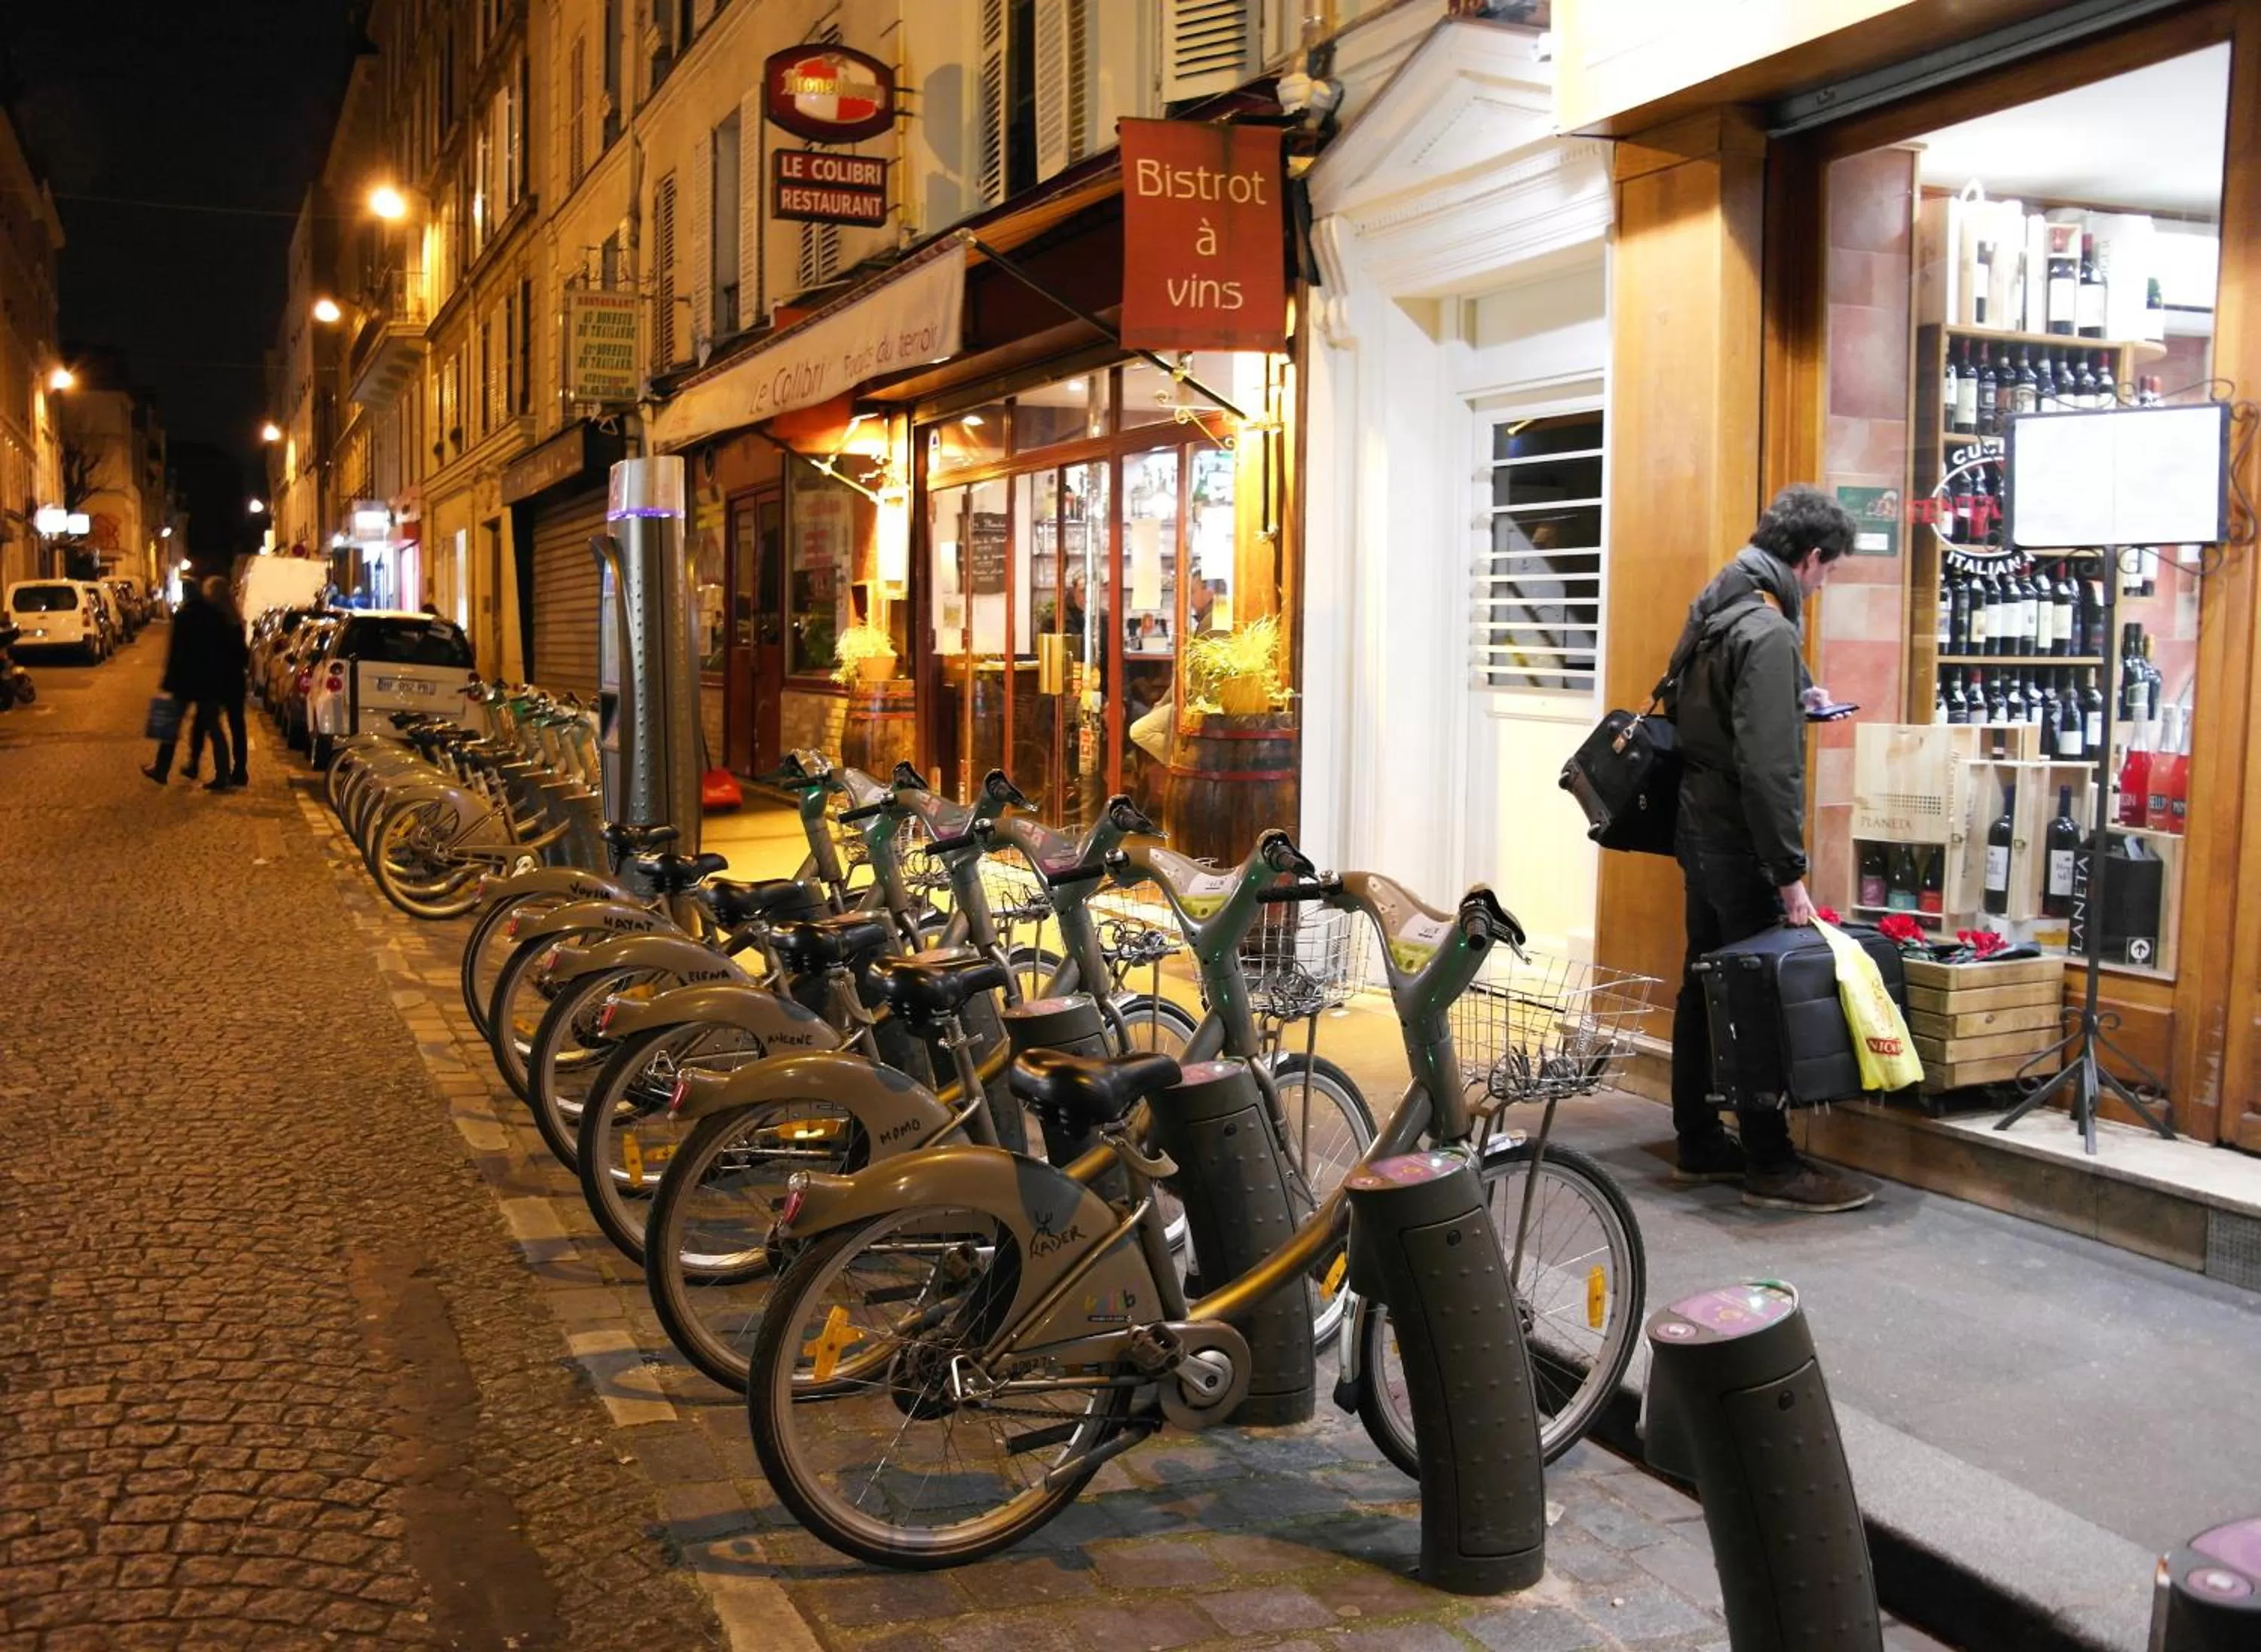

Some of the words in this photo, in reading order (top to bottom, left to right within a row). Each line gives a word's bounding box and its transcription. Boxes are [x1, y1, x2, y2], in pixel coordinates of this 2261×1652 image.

[782, 156, 803, 178] LE
[811, 159, 881, 185] COLIBRI
[1137, 158, 1267, 205] Bistrot
[781, 189, 882, 218] RESTAURANT
[1196, 217, 1216, 255] à
[1167, 274, 1244, 310] vins
[749, 381, 768, 415] Le
[773, 356, 827, 407] Colibri
[877, 336, 892, 363] du
[898, 324, 939, 359] terroir
[2070, 855, 2090, 955] LANETA
[604, 916, 654, 932] HAYAT
[880, 1118, 921, 1145] MOMO
